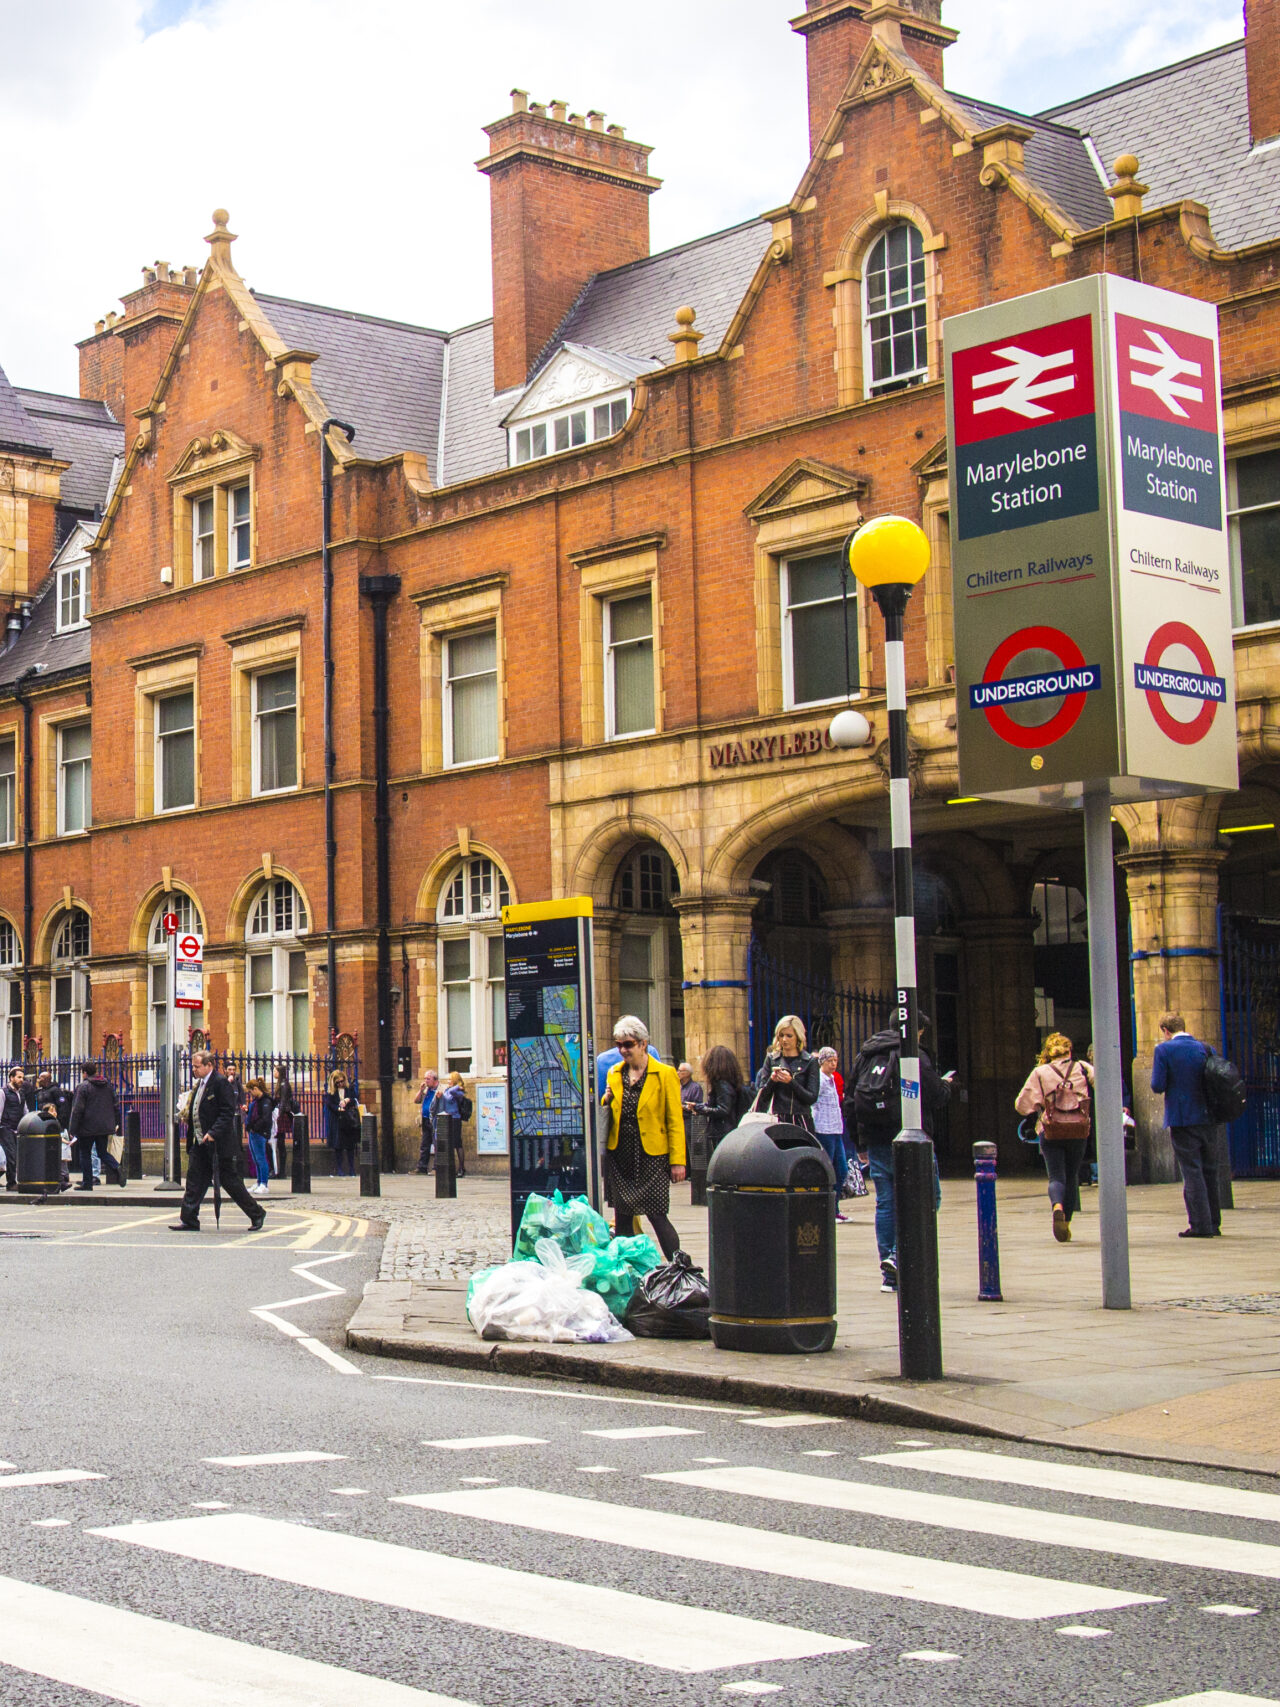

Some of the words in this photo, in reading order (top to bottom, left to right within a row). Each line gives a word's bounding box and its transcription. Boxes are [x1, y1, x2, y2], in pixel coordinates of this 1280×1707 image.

[966, 443, 1087, 486] Marylebone
[1127, 434, 1213, 475] Marylebone
[991, 483, 1062, 513] Station
[1146, 472, 1197, 504] Station
[966, 567, 1023, 589] Chiltern
[1028, 553, 1094, 577] Railways
[1129, 548, 1172, 570] Chiltern
[1175, 557, 1220, 582] Railways
[974, 671, 1094, 704] UNDERGROUND
[1137, 668, 1222, 698] UNDERGROUND
[169, 916, 176, 930] L
